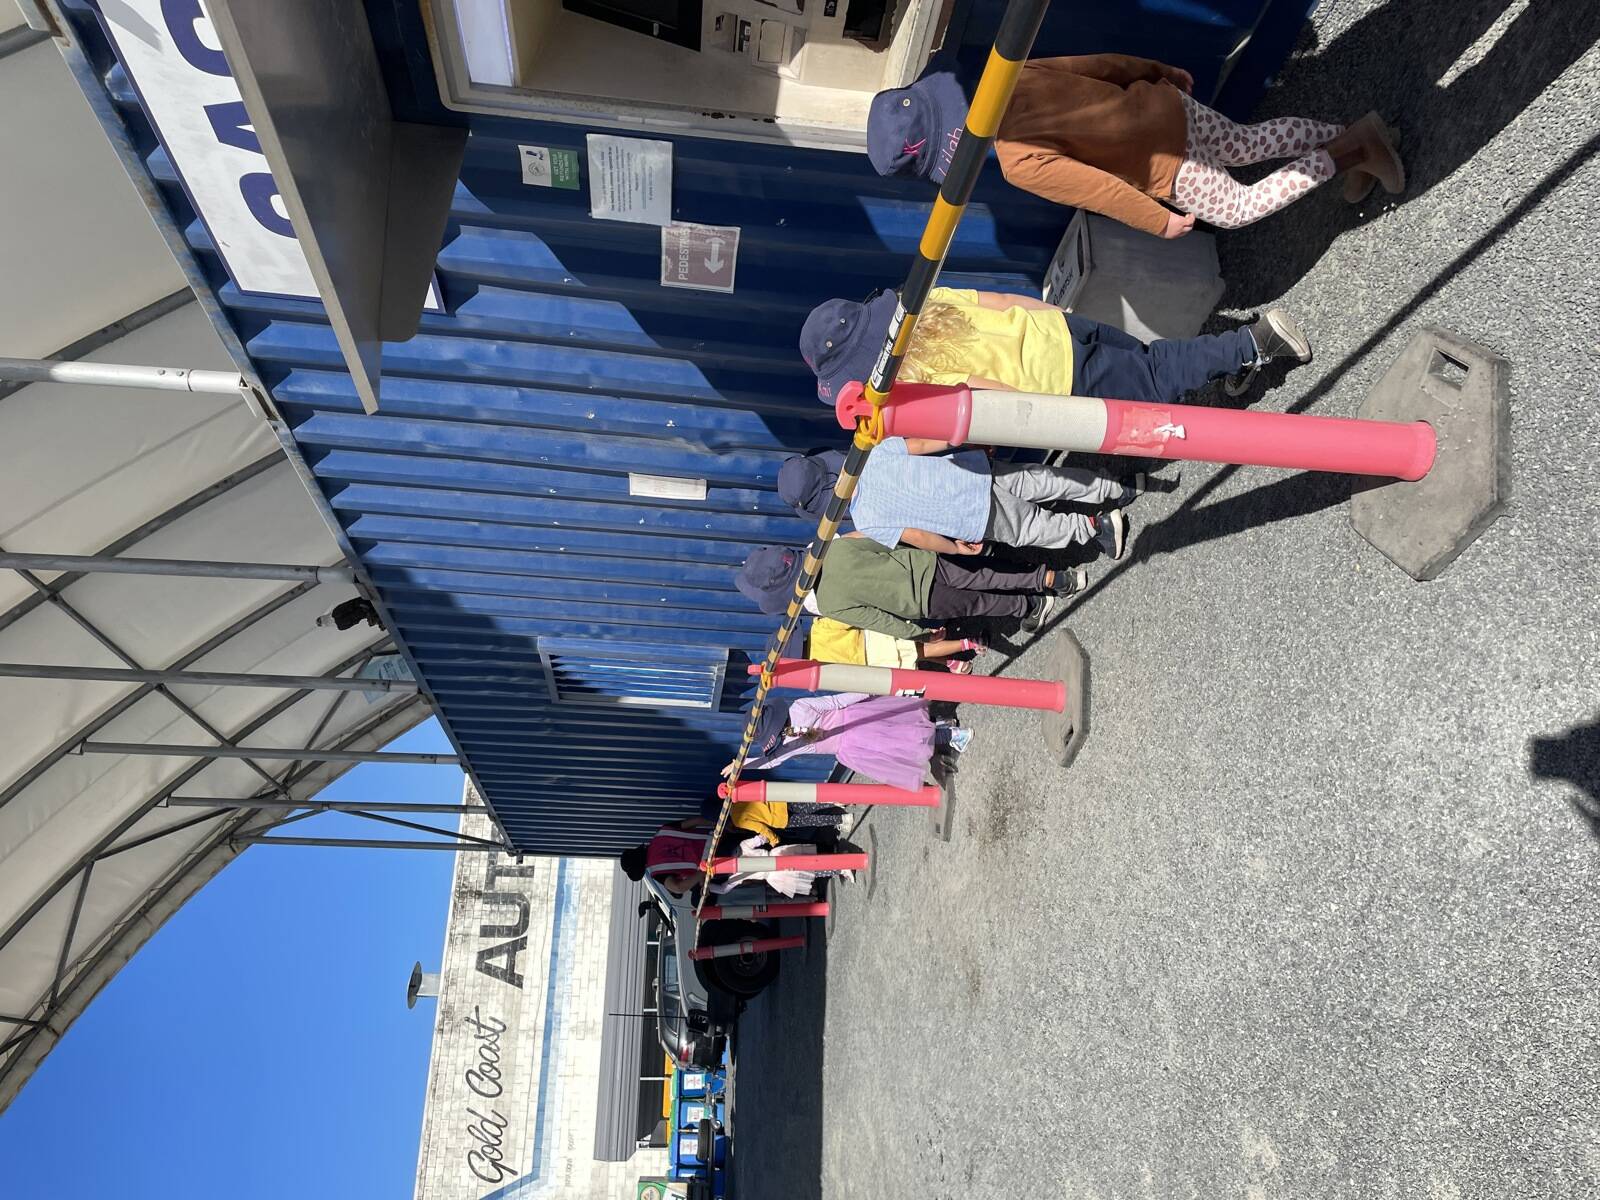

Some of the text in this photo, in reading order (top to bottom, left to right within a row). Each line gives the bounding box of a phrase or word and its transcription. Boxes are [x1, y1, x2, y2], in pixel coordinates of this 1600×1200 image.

[464, 820, 535, 1183] Gold Coast AUT
